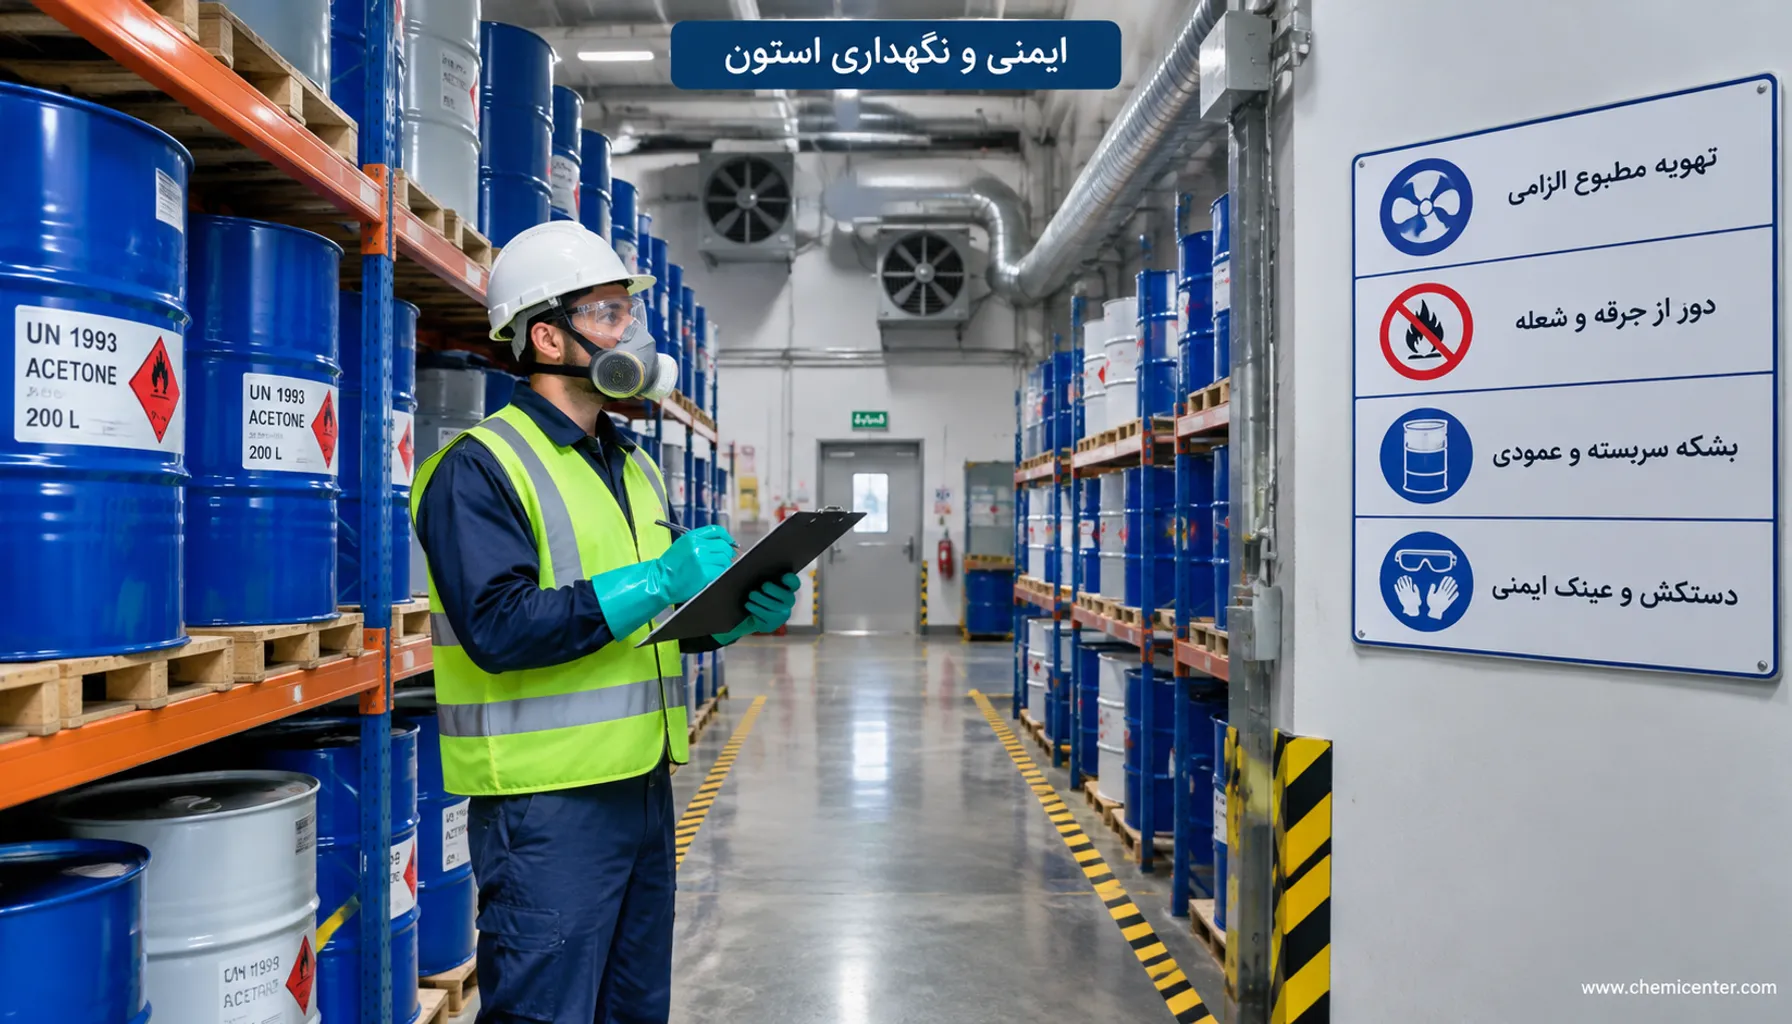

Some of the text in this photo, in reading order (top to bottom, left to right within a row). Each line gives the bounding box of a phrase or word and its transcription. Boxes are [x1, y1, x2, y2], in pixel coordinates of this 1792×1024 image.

[1508, 146, 1718, 206] تهویه مطبوع الزامی
[1515, 307, 1568, 330] شعله
[1574, 312, 1587, 333] و
[1594, 300, 1647, 330] جرقه
[1651, 297, 1670, 328] از
[27, 321, 117, 353] UN 1993
[25, 357, 117, 386] ACETONE
[249, 384, 305, 405] UN 1993
[26, 407, 63, 428] 200
[69, 410, 80, 429] L
[248, 409, 305, 429] ACETONE
[249, 445, 282, 460] 200 L
[1492, 434, 1739, 468] بشکه سربسته و عمودی
[1492, 574, 1739, 609] دستکش و عینک ایمنی
